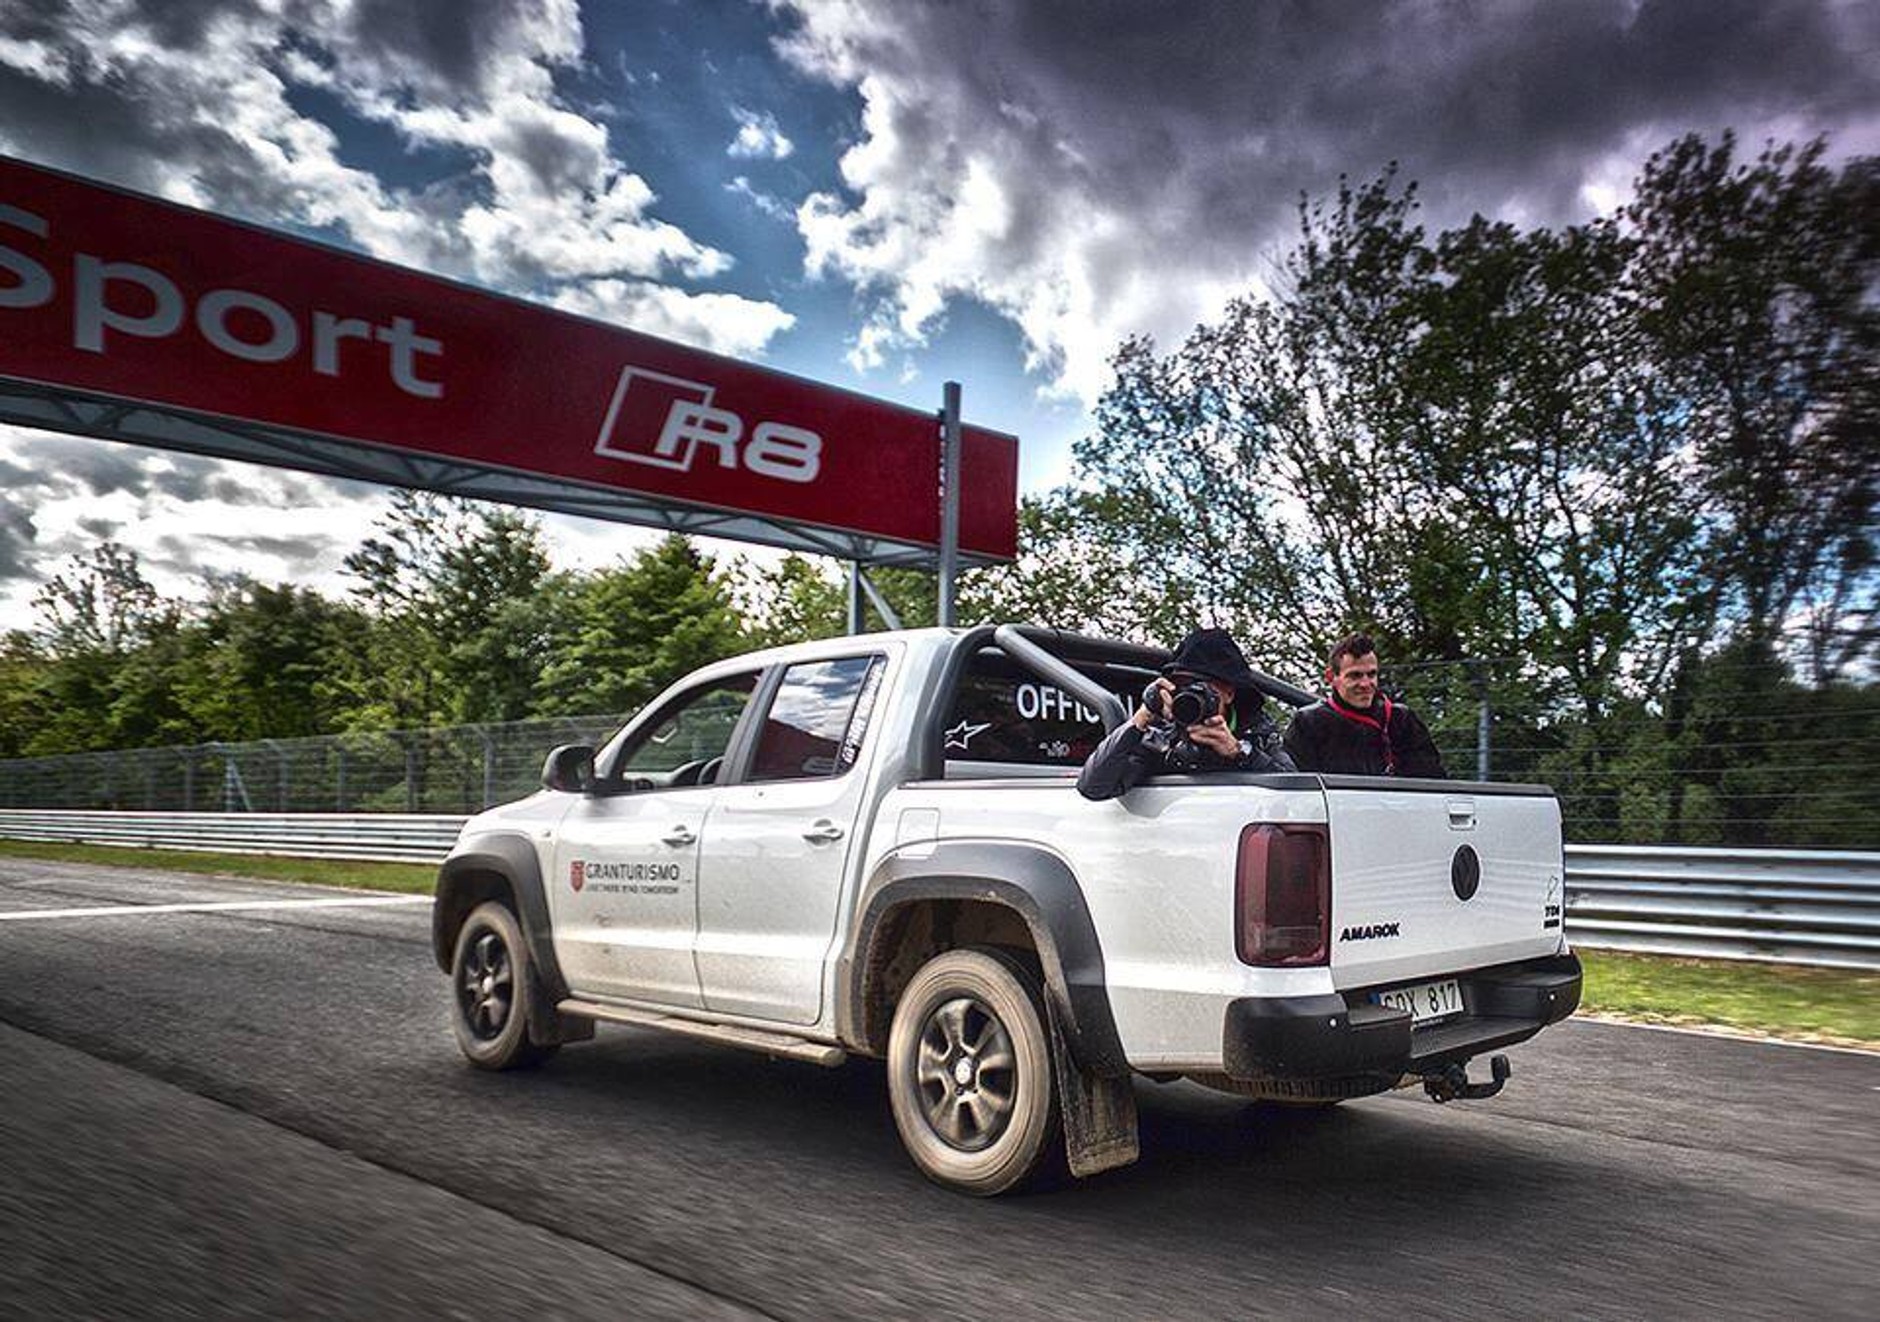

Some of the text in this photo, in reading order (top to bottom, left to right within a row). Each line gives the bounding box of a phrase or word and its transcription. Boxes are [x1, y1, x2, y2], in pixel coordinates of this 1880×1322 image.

[0, 205, 444, 398] Sport
[654, 399, 822, 483] R8
[1017, 683, 1134, 724] OFFIC
[585, 863, 680, 881] GRANTURISMO
[1339, 922, 1400, 942] AMAROK
[1427, 982, 1457, 1013] 817
